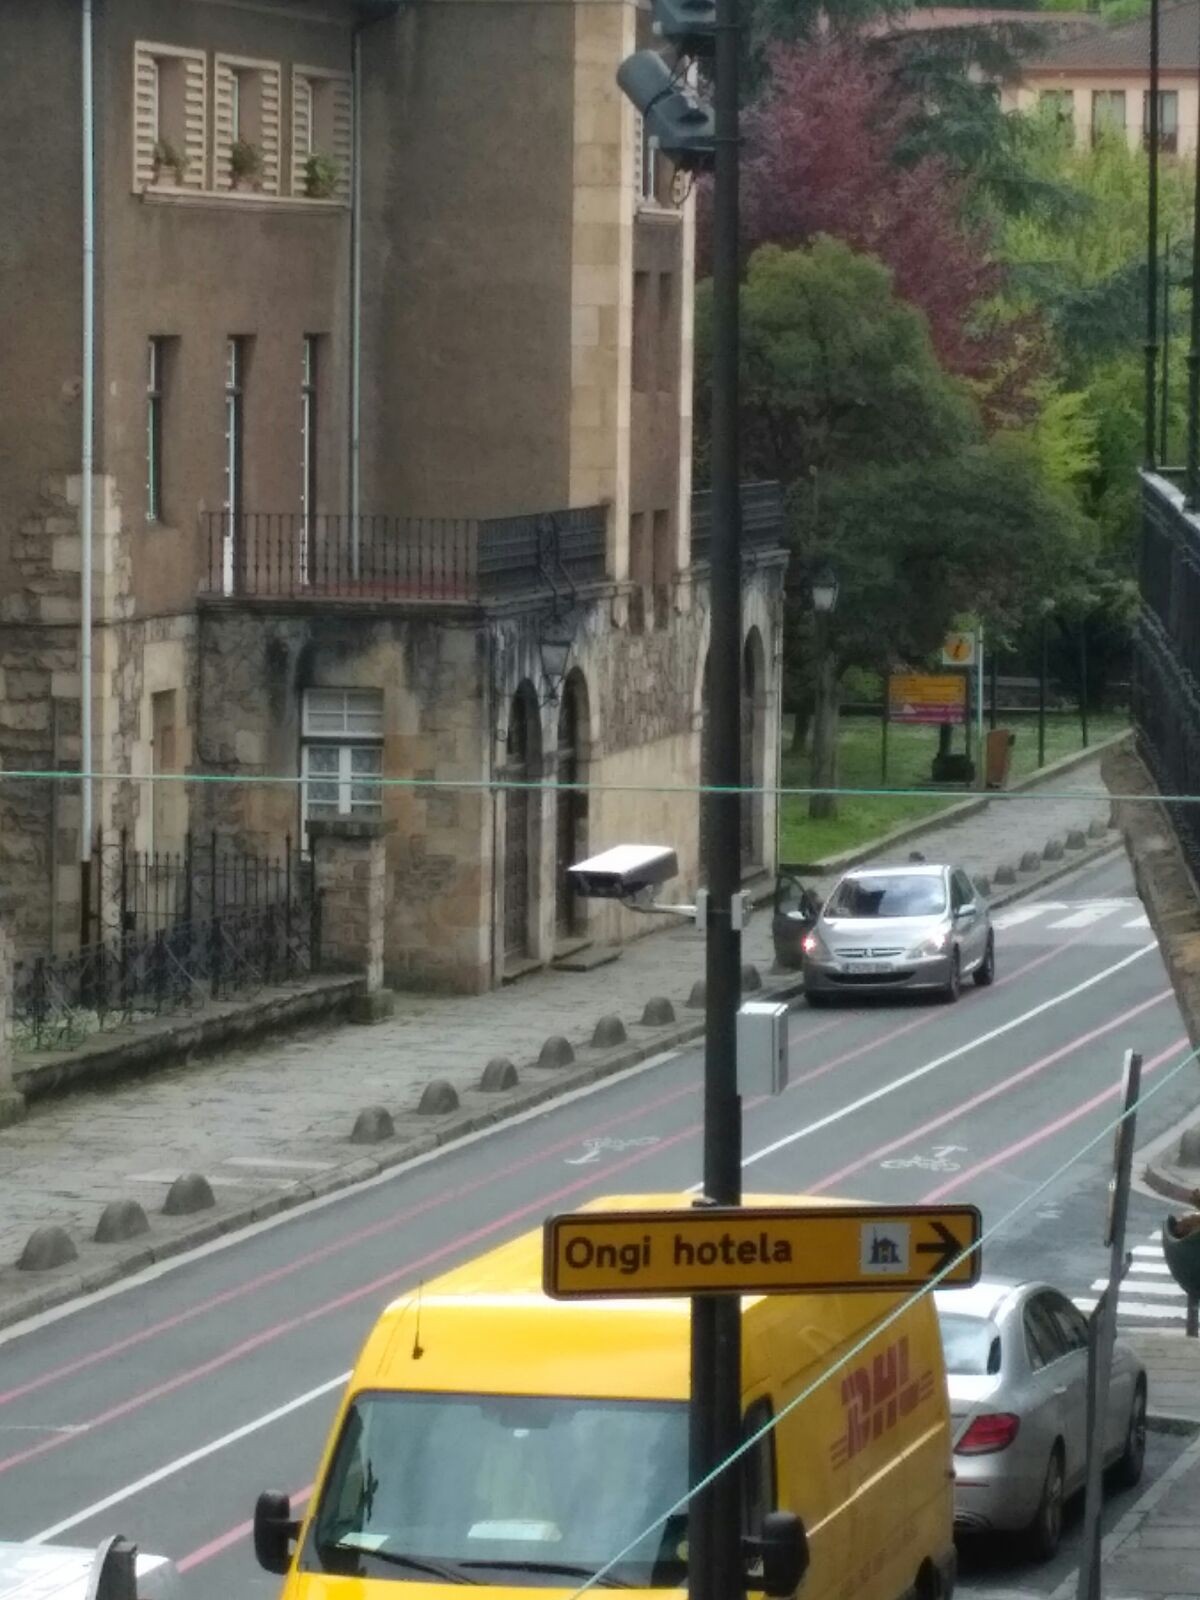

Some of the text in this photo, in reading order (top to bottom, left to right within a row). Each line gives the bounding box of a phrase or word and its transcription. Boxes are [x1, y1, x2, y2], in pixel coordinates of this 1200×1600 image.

[564, 1232, 793, 1275] Ongi hotela
[840, 1335, 921, 1459] DHL
